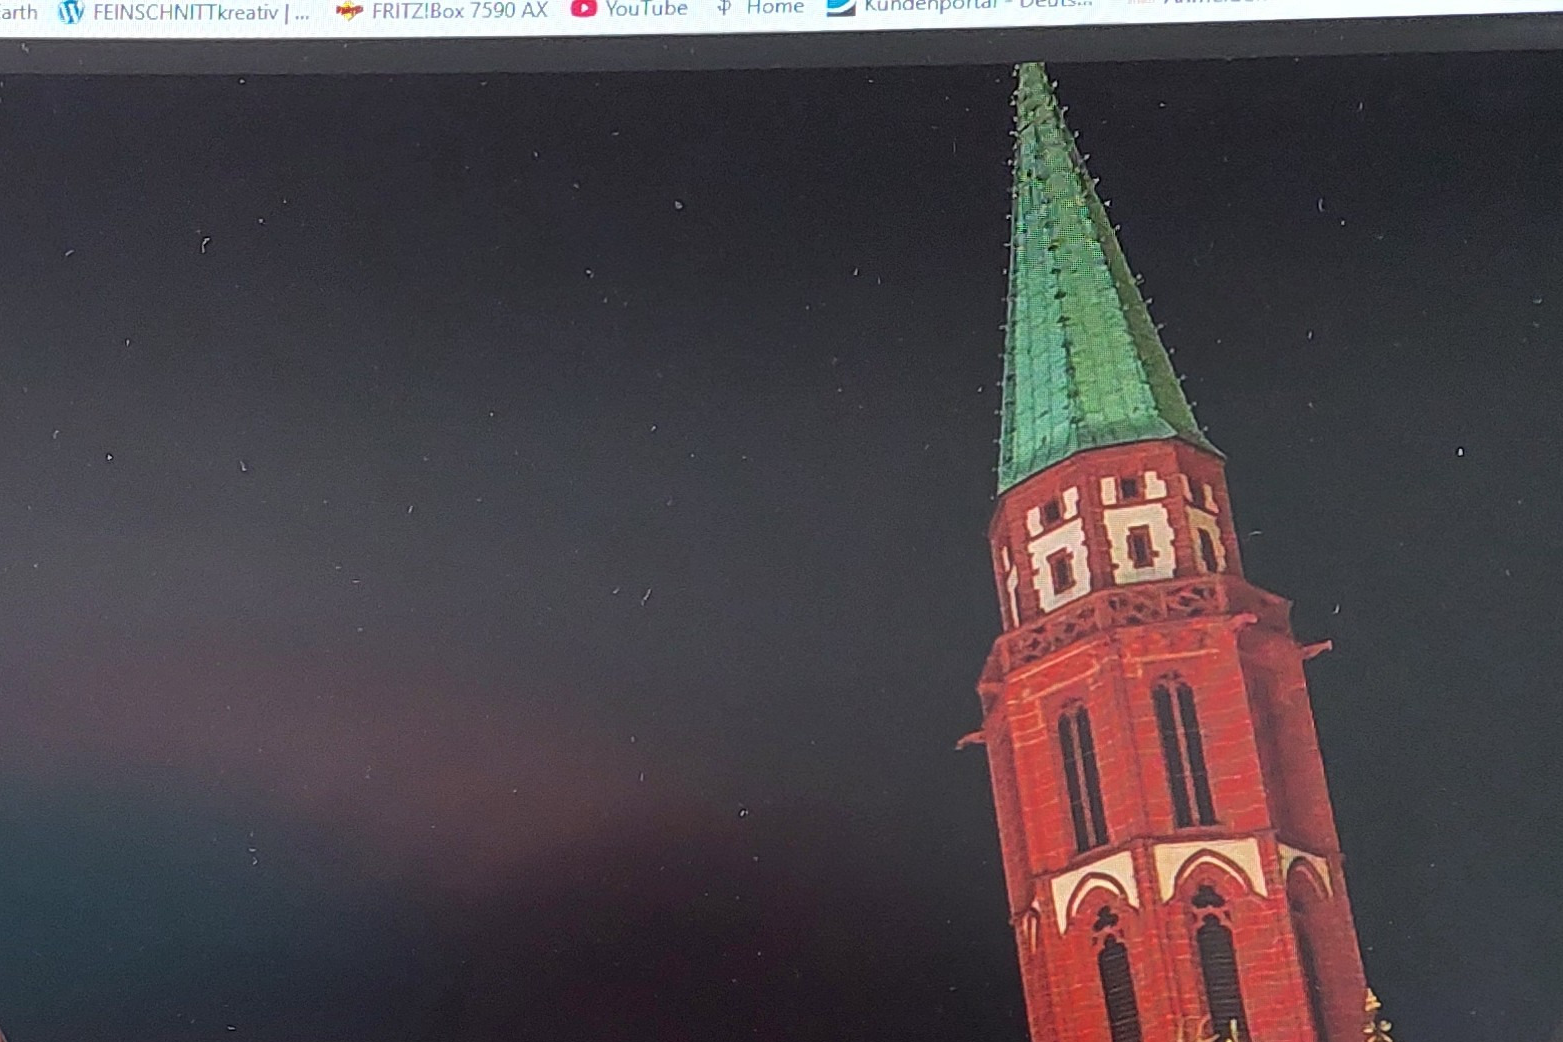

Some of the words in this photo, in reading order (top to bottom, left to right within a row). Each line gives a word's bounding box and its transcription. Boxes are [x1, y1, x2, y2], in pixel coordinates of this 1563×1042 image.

[93, 3, 279, 20] FEINSCHNITTkreativ
[372, 3, 465, 19] FRITZ!Box
[470, 1, 516, 19] 7590
[521, 1, 549, 18] AX
[606, 0, 688, 17] YouTube
[747, 0, 805, 14] Home
[865, 0, 997, 14] Kundenportal
